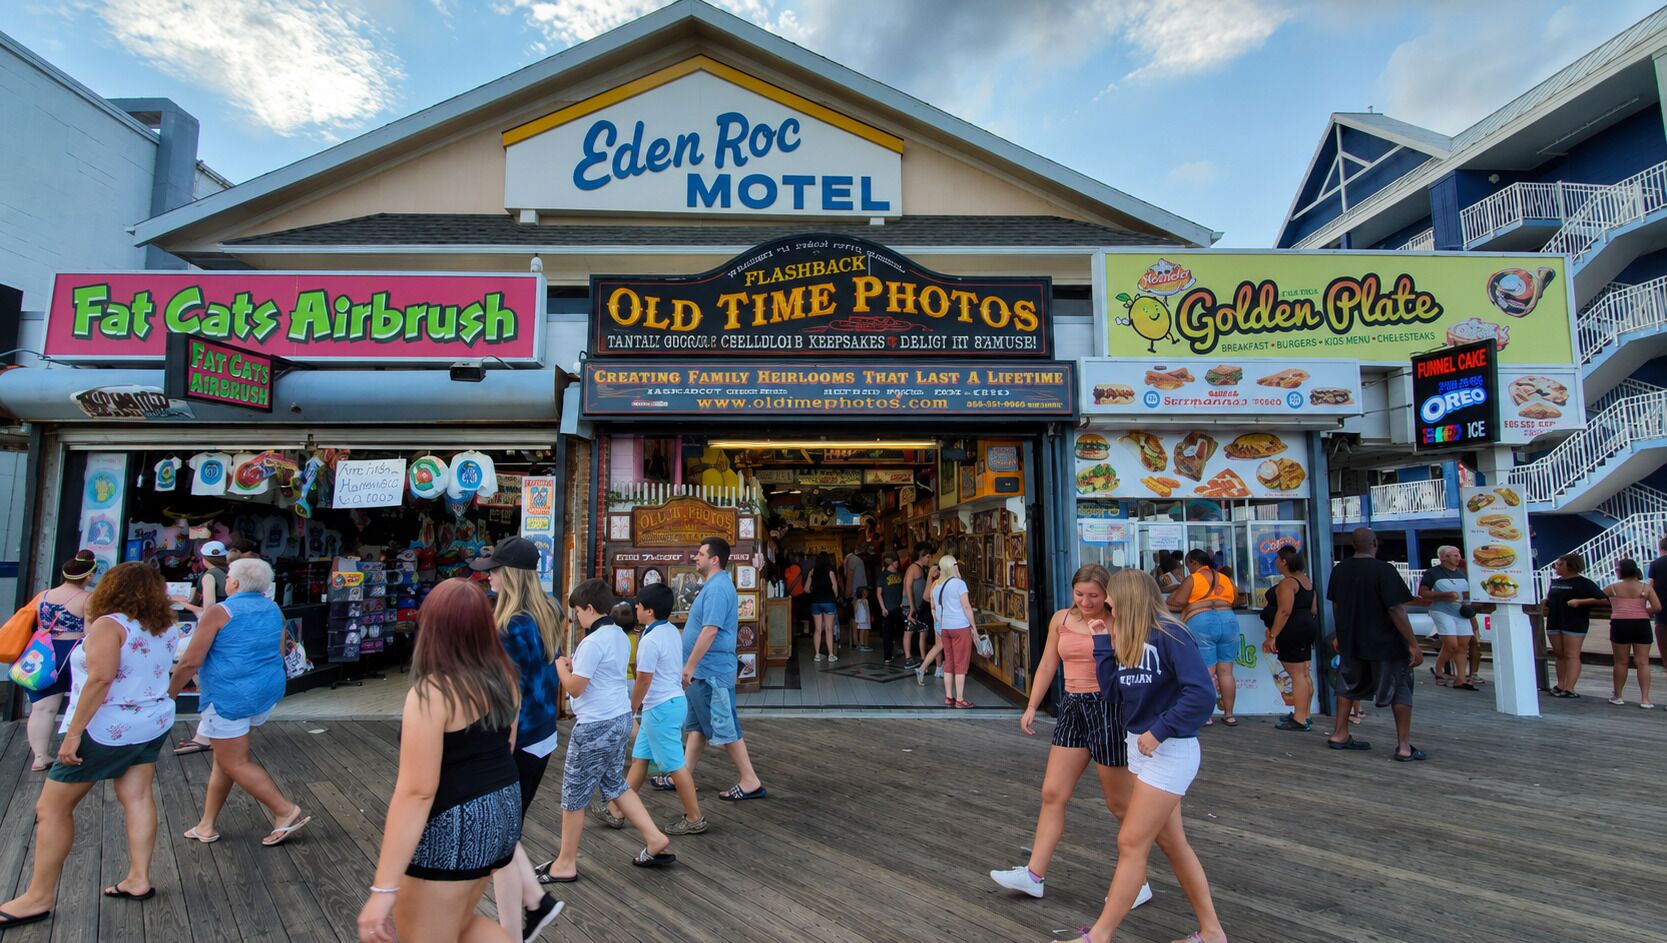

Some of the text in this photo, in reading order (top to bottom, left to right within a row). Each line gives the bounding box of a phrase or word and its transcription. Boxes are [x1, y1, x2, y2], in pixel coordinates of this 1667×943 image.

[573, 111, 801, 190] Eden Roc
[686, 173, 891, 211] MOTEL
[745, 255, 866, 287] FLASHBACK
[72, 283, 519, 348] Fat Cats Airbrush
[606, 274, 1039, 332] OLD TIME PHOTOS
[1175, 272, 1444, 355] Golden Plate
[808, 335, 885, 349] KEEPSAKES
[1221, 341, 1269, 353] BREAKFAST
[1276, 338, 1317, 349] BURGERS
[1324, 337, 1344, 346] KIDS
[1346, 335, 1370, 344] MENU
[191, 341, 269, 385] FAT CATS
[594, 370, 1064, 385] CREATING FAMILY HEIRLOOMS THAT LAST A LIFETIME
[1417, 348, 1487, 379] FUNNEL CAKE
[1421, 386, 1488, 424] OREO
[1467, 420, 1486, 439] ICE
